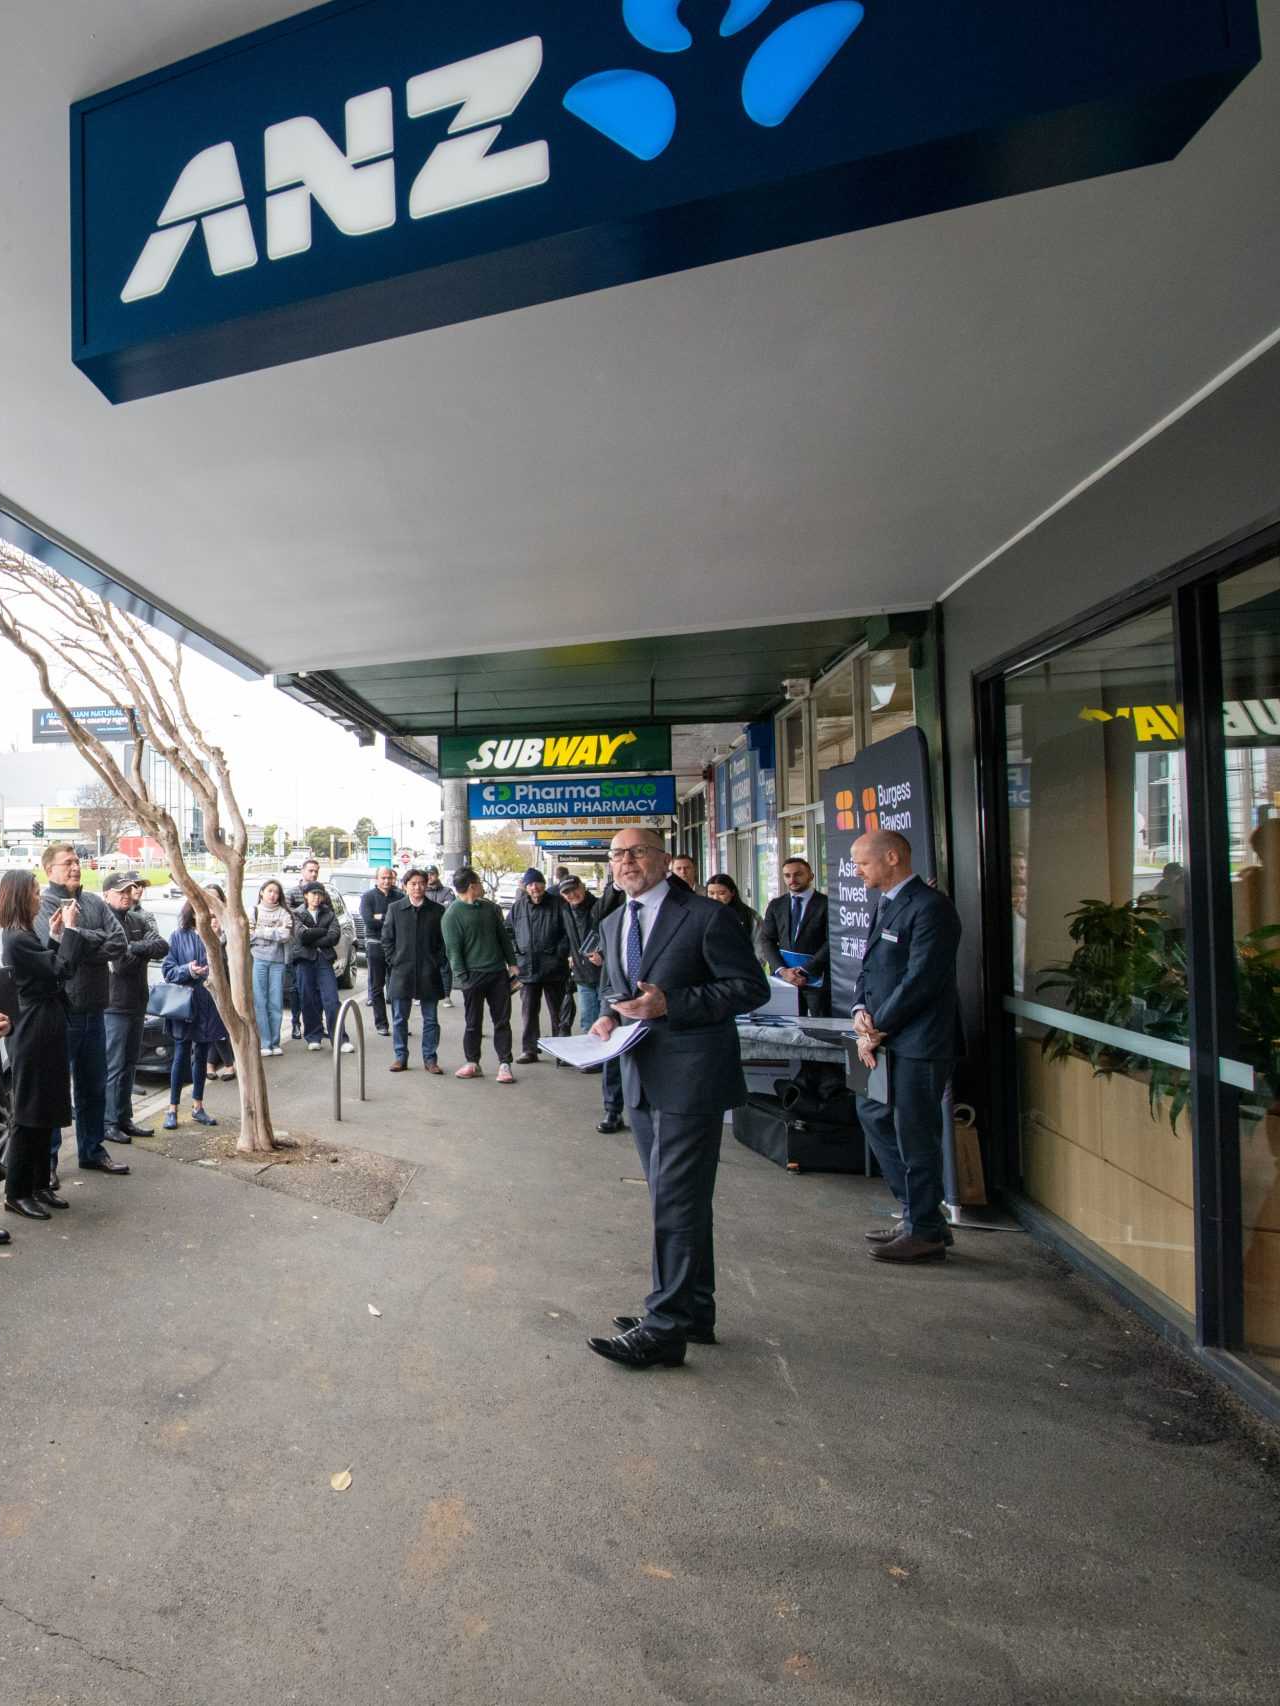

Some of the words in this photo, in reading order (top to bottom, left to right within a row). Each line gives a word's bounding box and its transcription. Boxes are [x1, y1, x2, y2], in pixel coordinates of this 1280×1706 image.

[120, 35, 550, 304] ANZ
[466, 731, 637, 770] SUBWAY
[515, 781, 657, 801] PharmaSave
[877, 781, 911, 809] Burgess
[482, 802, 568, 816] MOORABBIN
[574, 799, 657, 813] PHARMACY
[880, 811, 911, 831] Rawson
[838, 856, 858, 878] Asia
[839, 881, 868, 903] Invest
[840, 906, 870, 929] Servic
